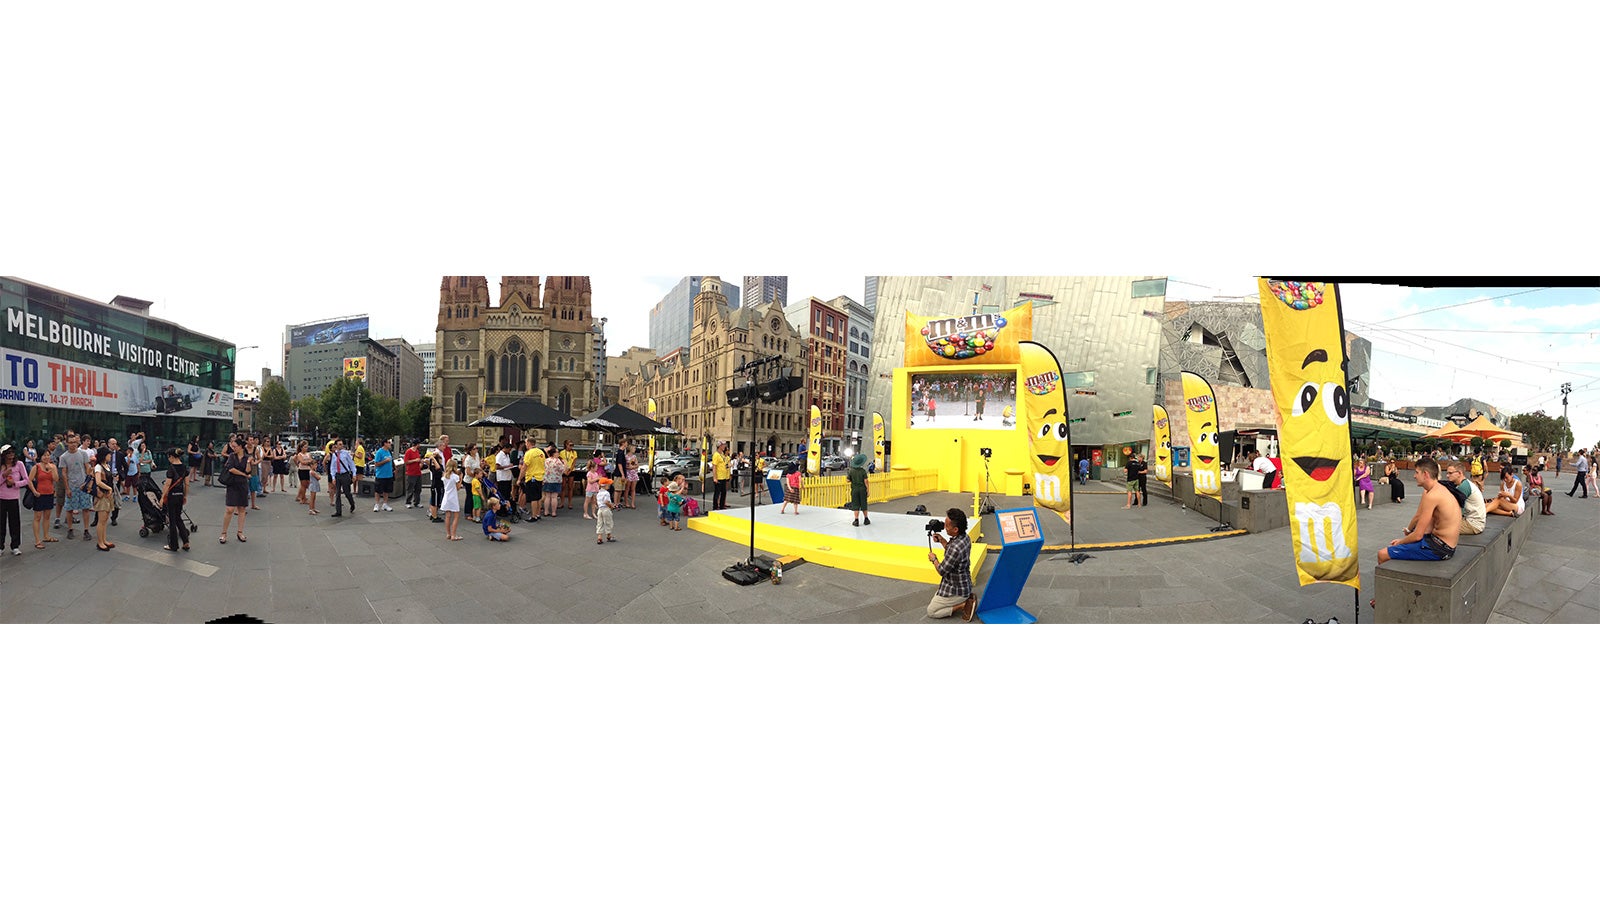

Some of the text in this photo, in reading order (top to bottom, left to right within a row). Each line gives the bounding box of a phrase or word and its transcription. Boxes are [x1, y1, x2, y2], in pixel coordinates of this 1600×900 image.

[7, 307, 200, 378] MELBOURNE VISITOR CENTRE
[5, 353, 119, 399] TO THRILL.
[28, 391, 48, 403] PRIX.
[49, 393, 68, 405] 14-17
[70, 396, 94, 408] MARCH.
[1034, 472, 1063, 503] m
[1195, 469, 1219, 492] m
[1295, 501, 1352, 563] m
